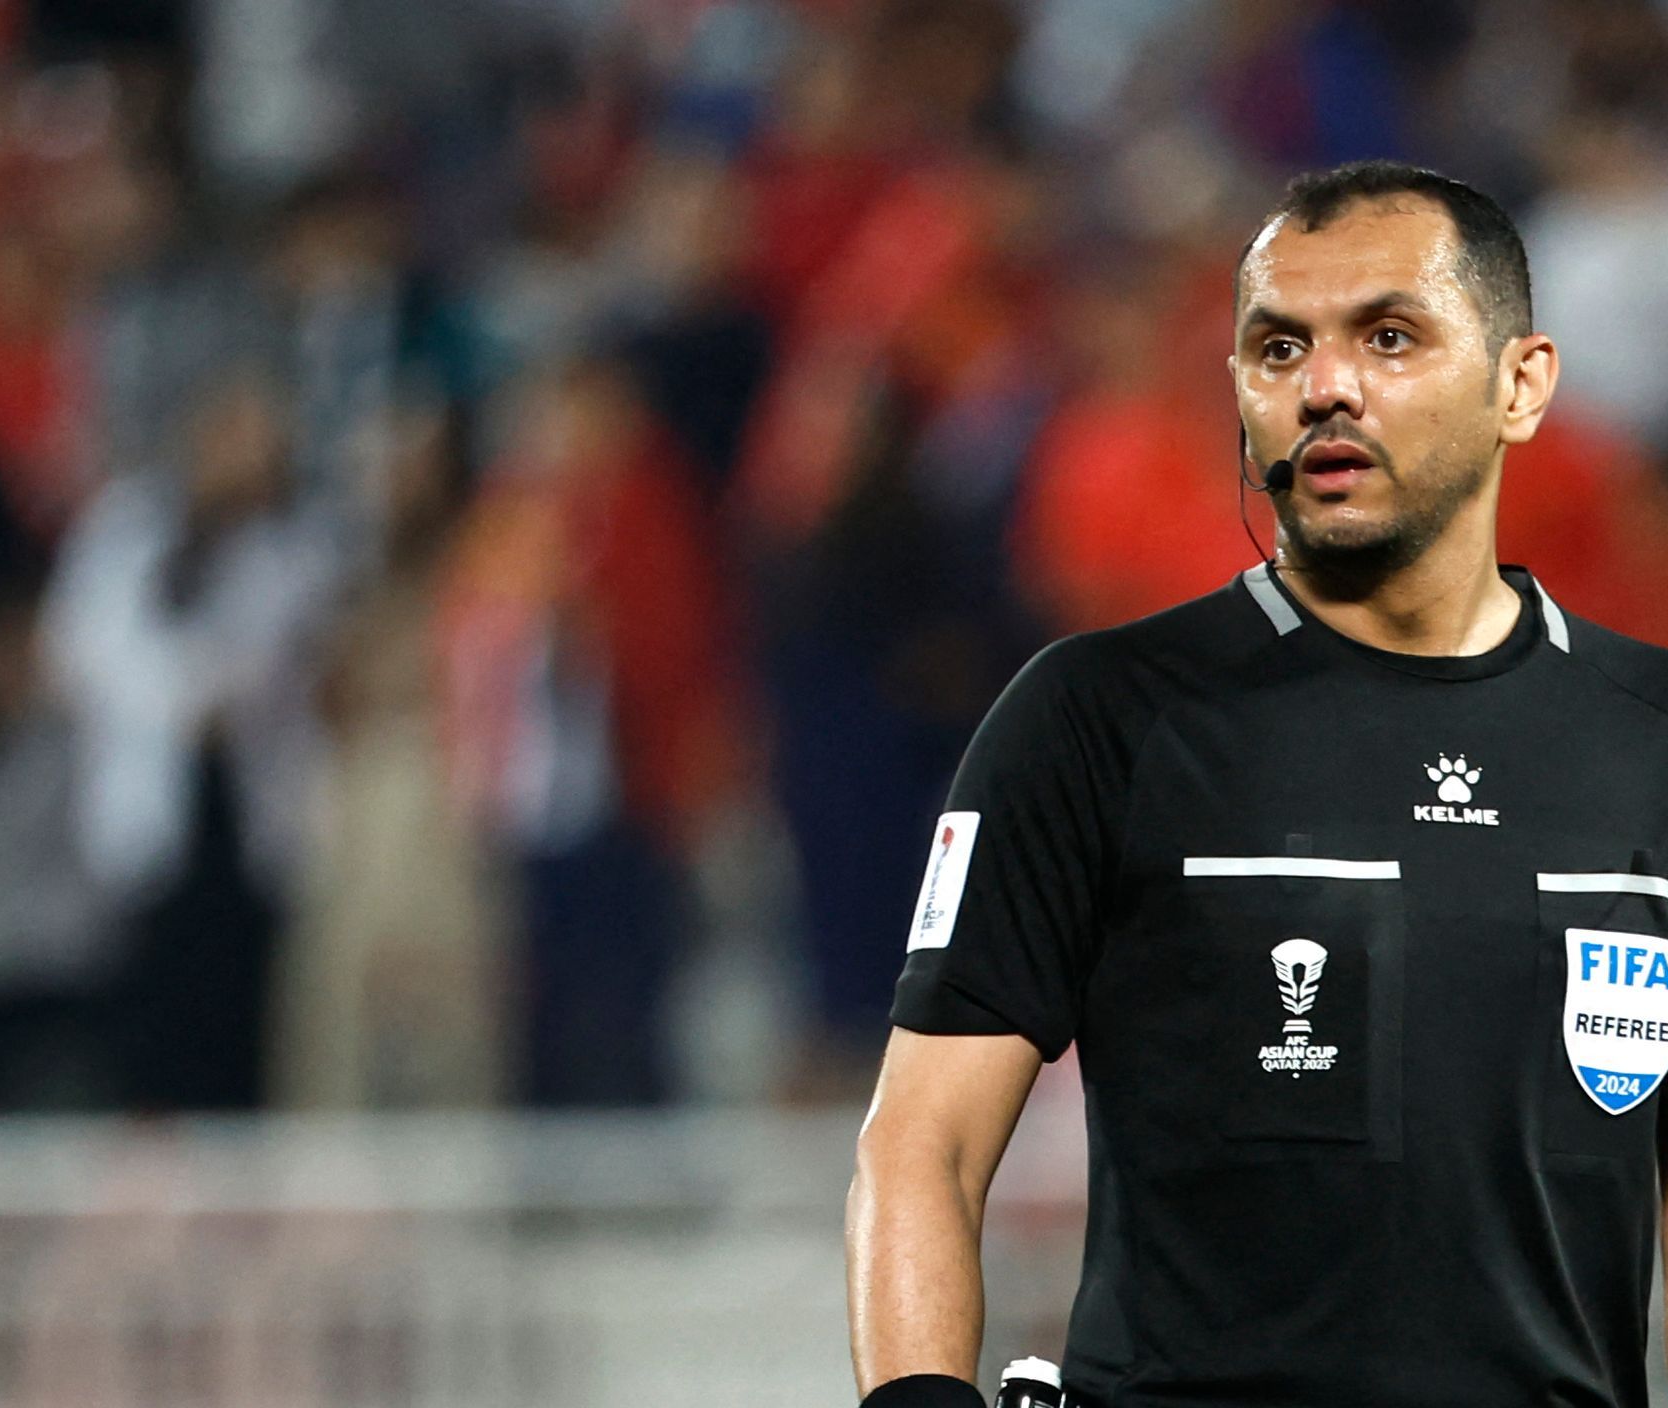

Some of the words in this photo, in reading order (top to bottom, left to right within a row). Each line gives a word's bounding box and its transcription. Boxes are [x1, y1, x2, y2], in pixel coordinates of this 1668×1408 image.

[1413, 805, 1500, 826] KELME
[1285, 1035, 1309, 1046] AFC
[1258, 1046, 1305, 1060] ASIAN
[1305, 1046, 1339, 1059] CUP
[1261, 1059, 1302, 1073] QATAR
[1595, 1073, 1641, 1097] 2024
